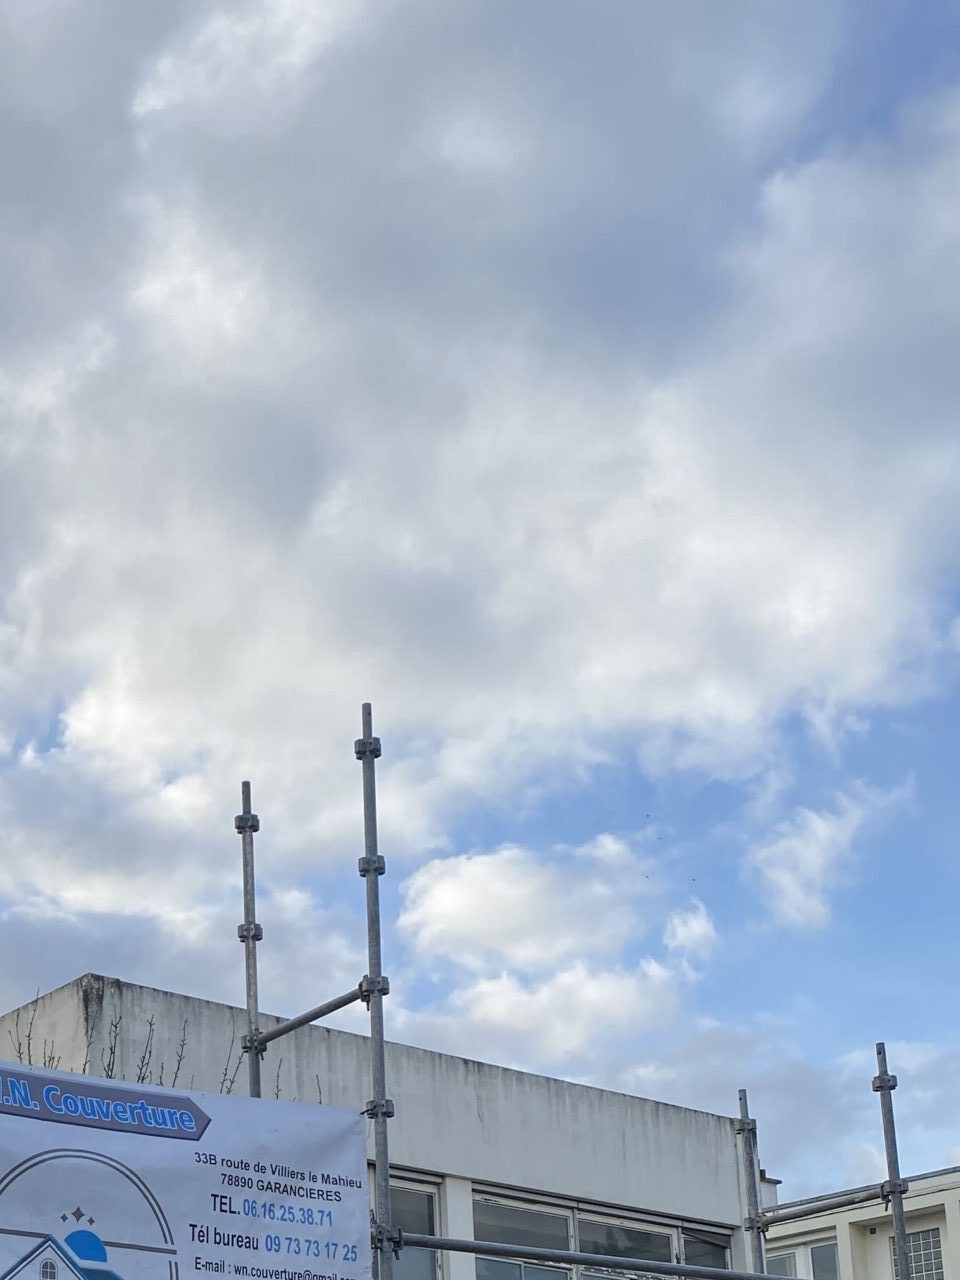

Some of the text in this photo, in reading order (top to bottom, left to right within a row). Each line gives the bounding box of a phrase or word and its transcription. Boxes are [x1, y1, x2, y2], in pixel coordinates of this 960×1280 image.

[43, 1085, 197, 1132] Couverture
[195, 1152, 362, 1189] 33B route de Villiers le Mahieu
[221, 1174, 342, 1202] 78890 GARANCIERES
[211, 1193, 333, 1228] TEL. 06.16.25.38.71
[189, 1224, 358, 1262] Tél bureau 09 73 73 17 25
[195, 1257, 225, 1274] E-mail
